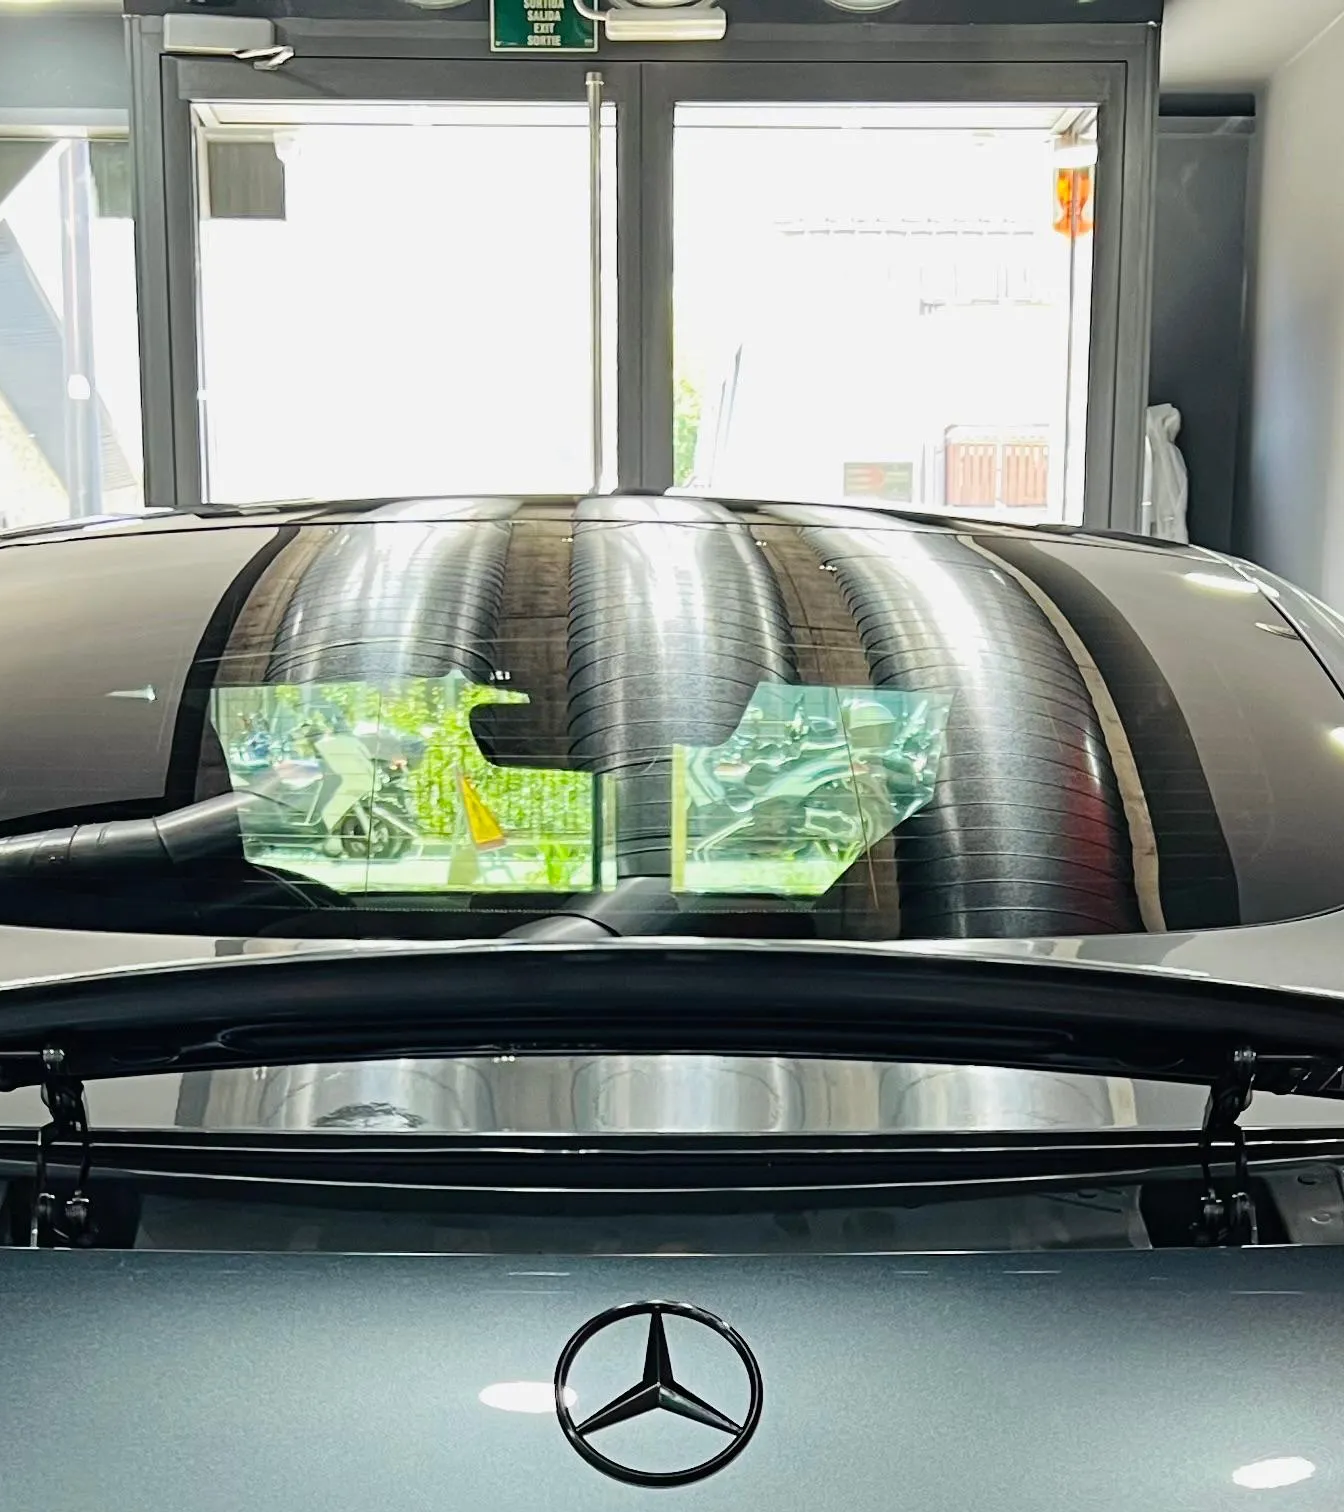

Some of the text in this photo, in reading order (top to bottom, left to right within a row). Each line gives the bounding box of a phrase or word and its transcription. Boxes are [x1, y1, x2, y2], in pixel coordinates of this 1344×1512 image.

[527, 10, 562, 21] SALIDA
[533, 22, 555, 34] EXIT
[527, 34, 562, 46] SORTIE
